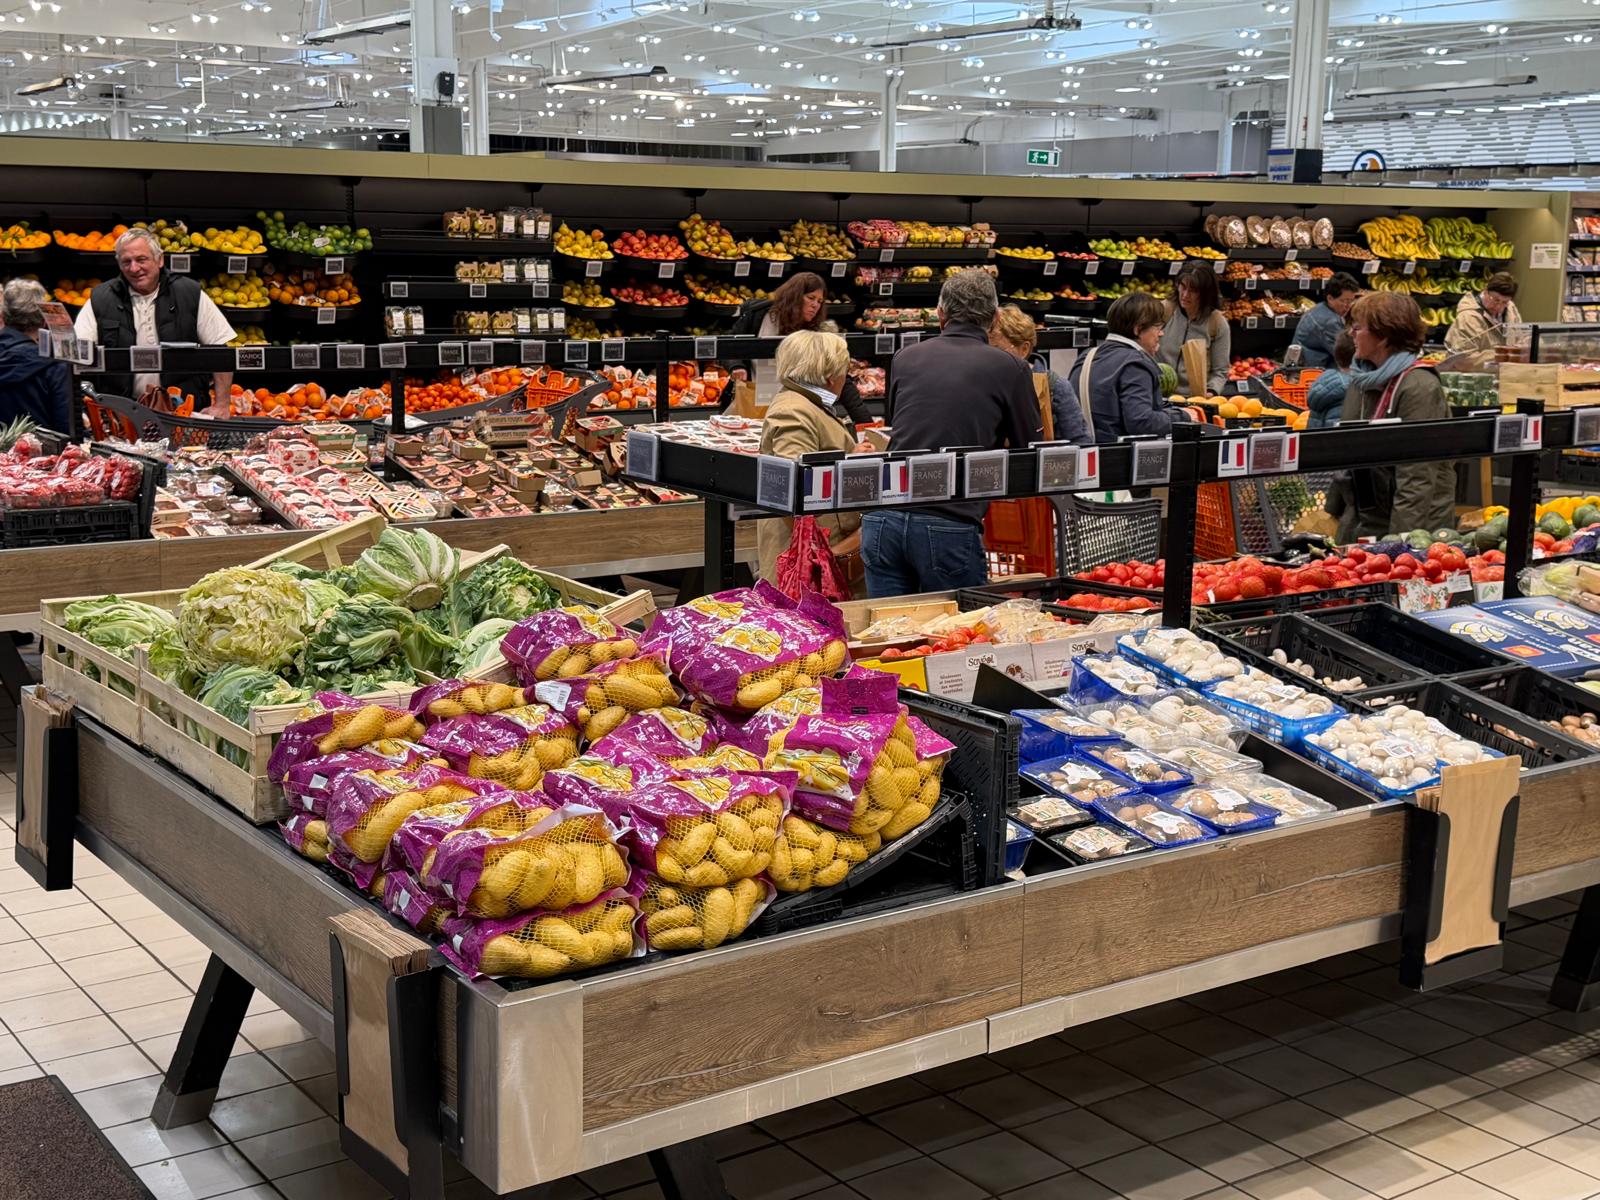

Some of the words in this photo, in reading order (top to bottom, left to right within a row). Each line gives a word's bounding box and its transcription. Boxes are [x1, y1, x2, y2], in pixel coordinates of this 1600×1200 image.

[1044, 460, 1072, 471] FRANCE
[1138, 455, 1165, 465] FRANCE
[913, 469, 943, 480] FRANCE
[969, 464, 1000, 477] FRANCE
[761, 471, 787, 487] FRANCE
[843, 474, 875, 489] FRANCE
[1072, 641, 1096, 653] Savéol
[968, 655, 994, 667] Savéol
